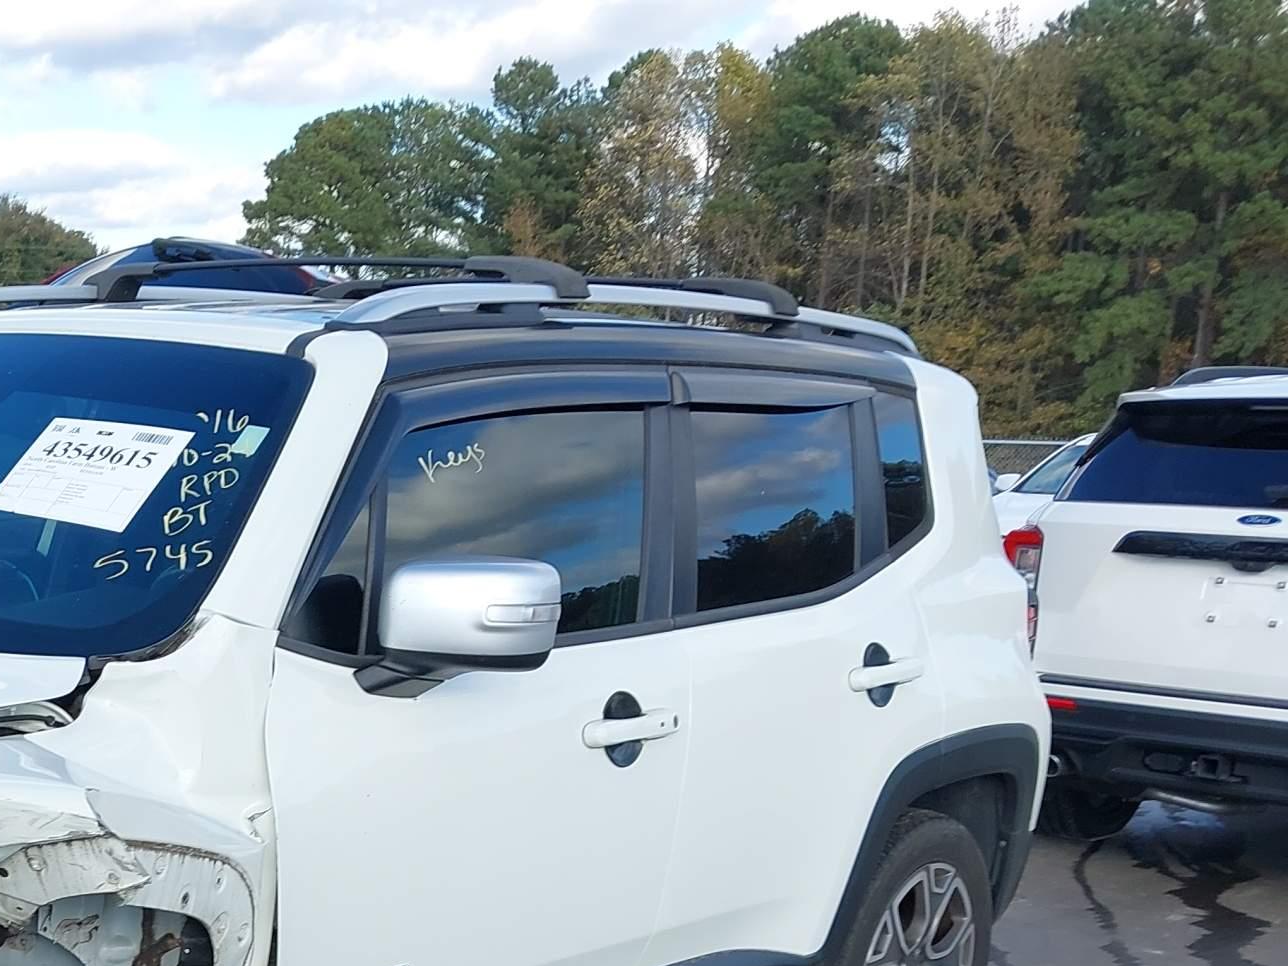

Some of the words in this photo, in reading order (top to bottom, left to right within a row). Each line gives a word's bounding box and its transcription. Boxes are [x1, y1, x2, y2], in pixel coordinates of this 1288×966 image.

[42, 440, 159, 469] 43549615
[180, 467, 240, 502] RPD
[163, 500, 213, 536] BT
[93, 540, 214, 581] 5745
